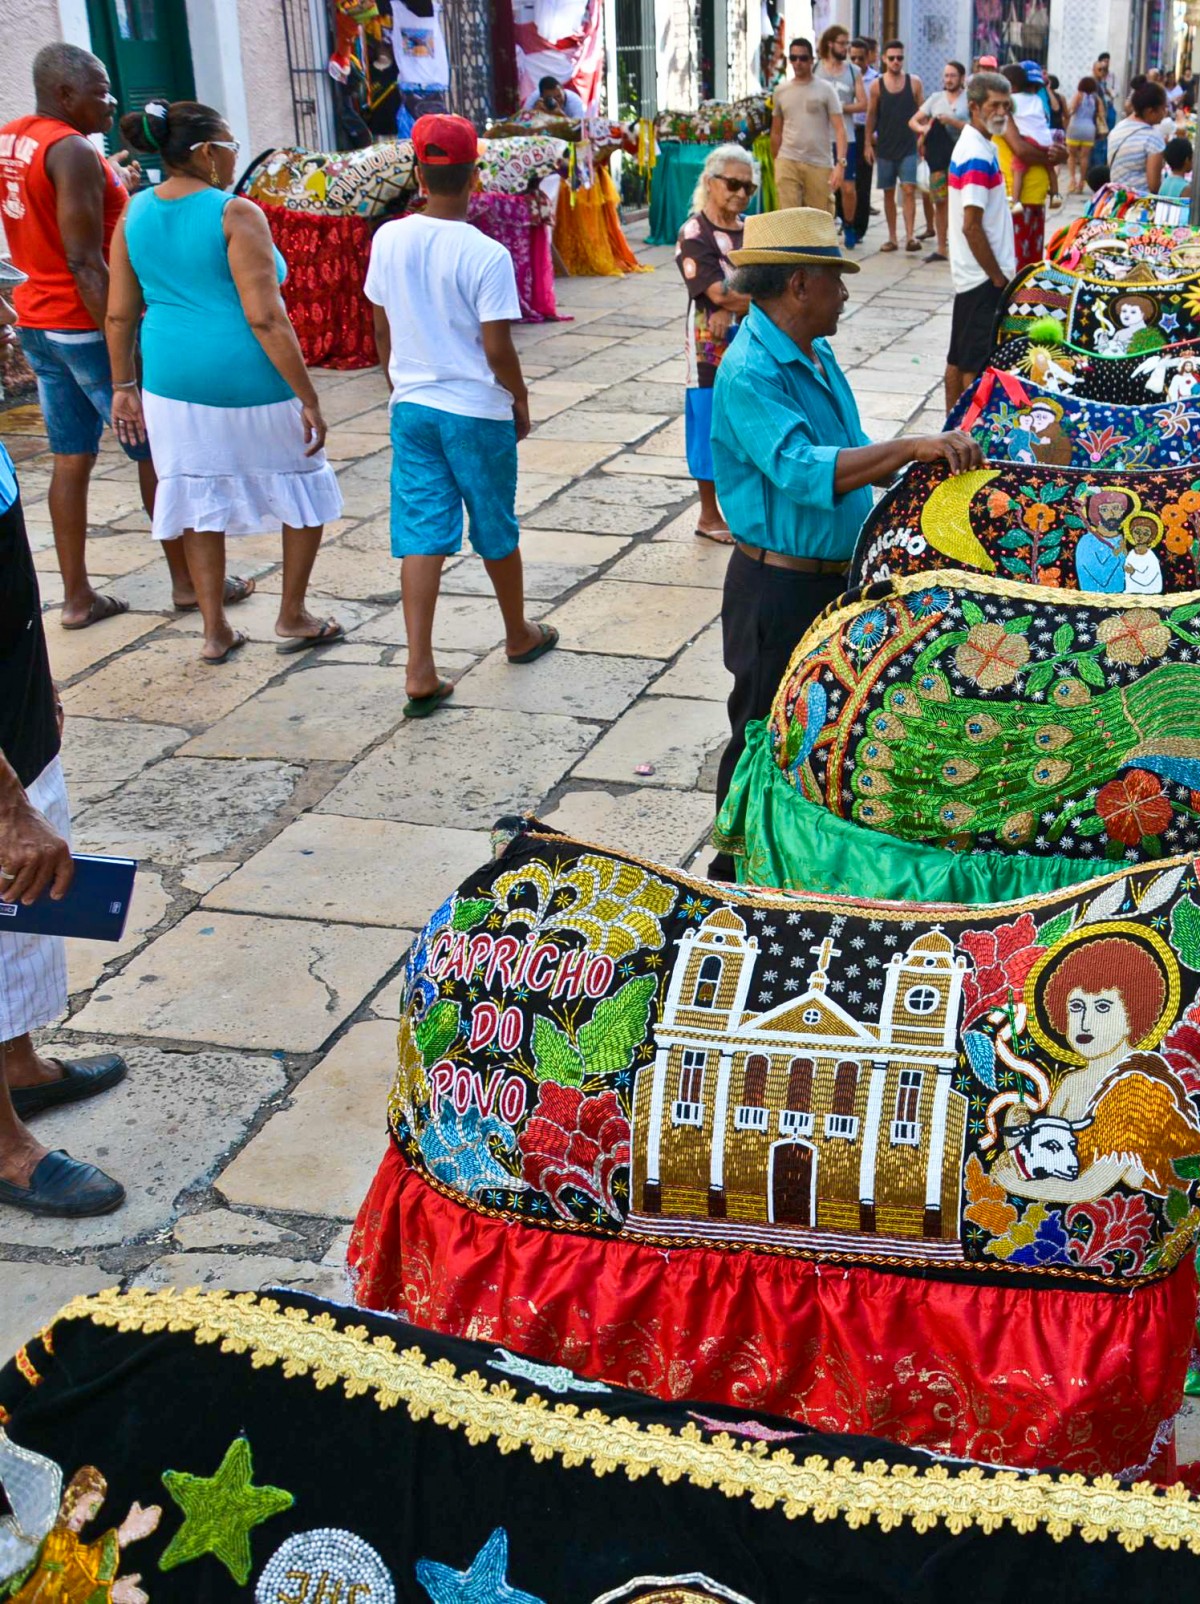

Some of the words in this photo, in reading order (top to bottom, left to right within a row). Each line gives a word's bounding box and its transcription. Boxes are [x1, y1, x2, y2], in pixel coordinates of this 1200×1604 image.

[1080, 280, 1119, 294] MATA
[1126, 282, 1185, 292] GRANDE
[428, 931, 615, 1000] CAPRICHO
[468, 1002, 524, 1053] DO
[428, 1060, 527, 1125] POVO
